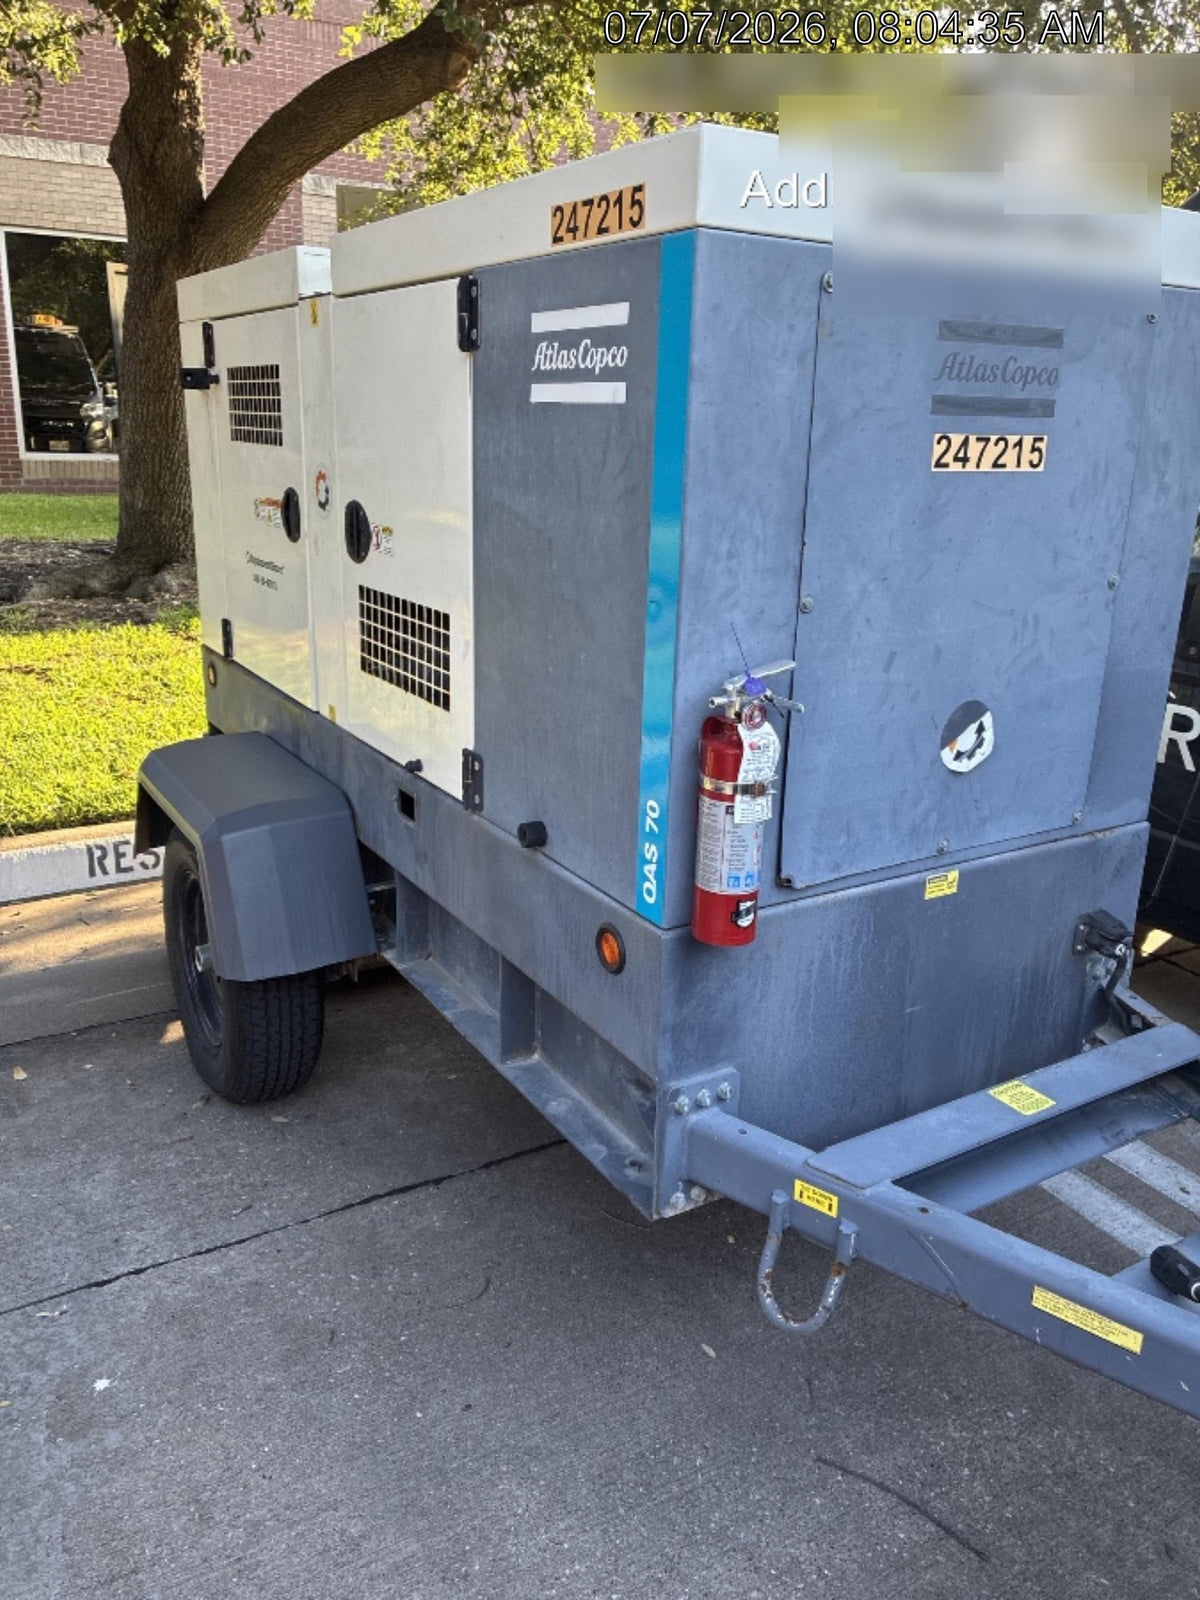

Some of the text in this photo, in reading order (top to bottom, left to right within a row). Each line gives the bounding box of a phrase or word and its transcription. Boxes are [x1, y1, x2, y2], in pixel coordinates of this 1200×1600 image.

[552, 184, 644, 244] 247215
[933, 434, 1045, 469] 247215
[645, 799, 660, 834] 70
